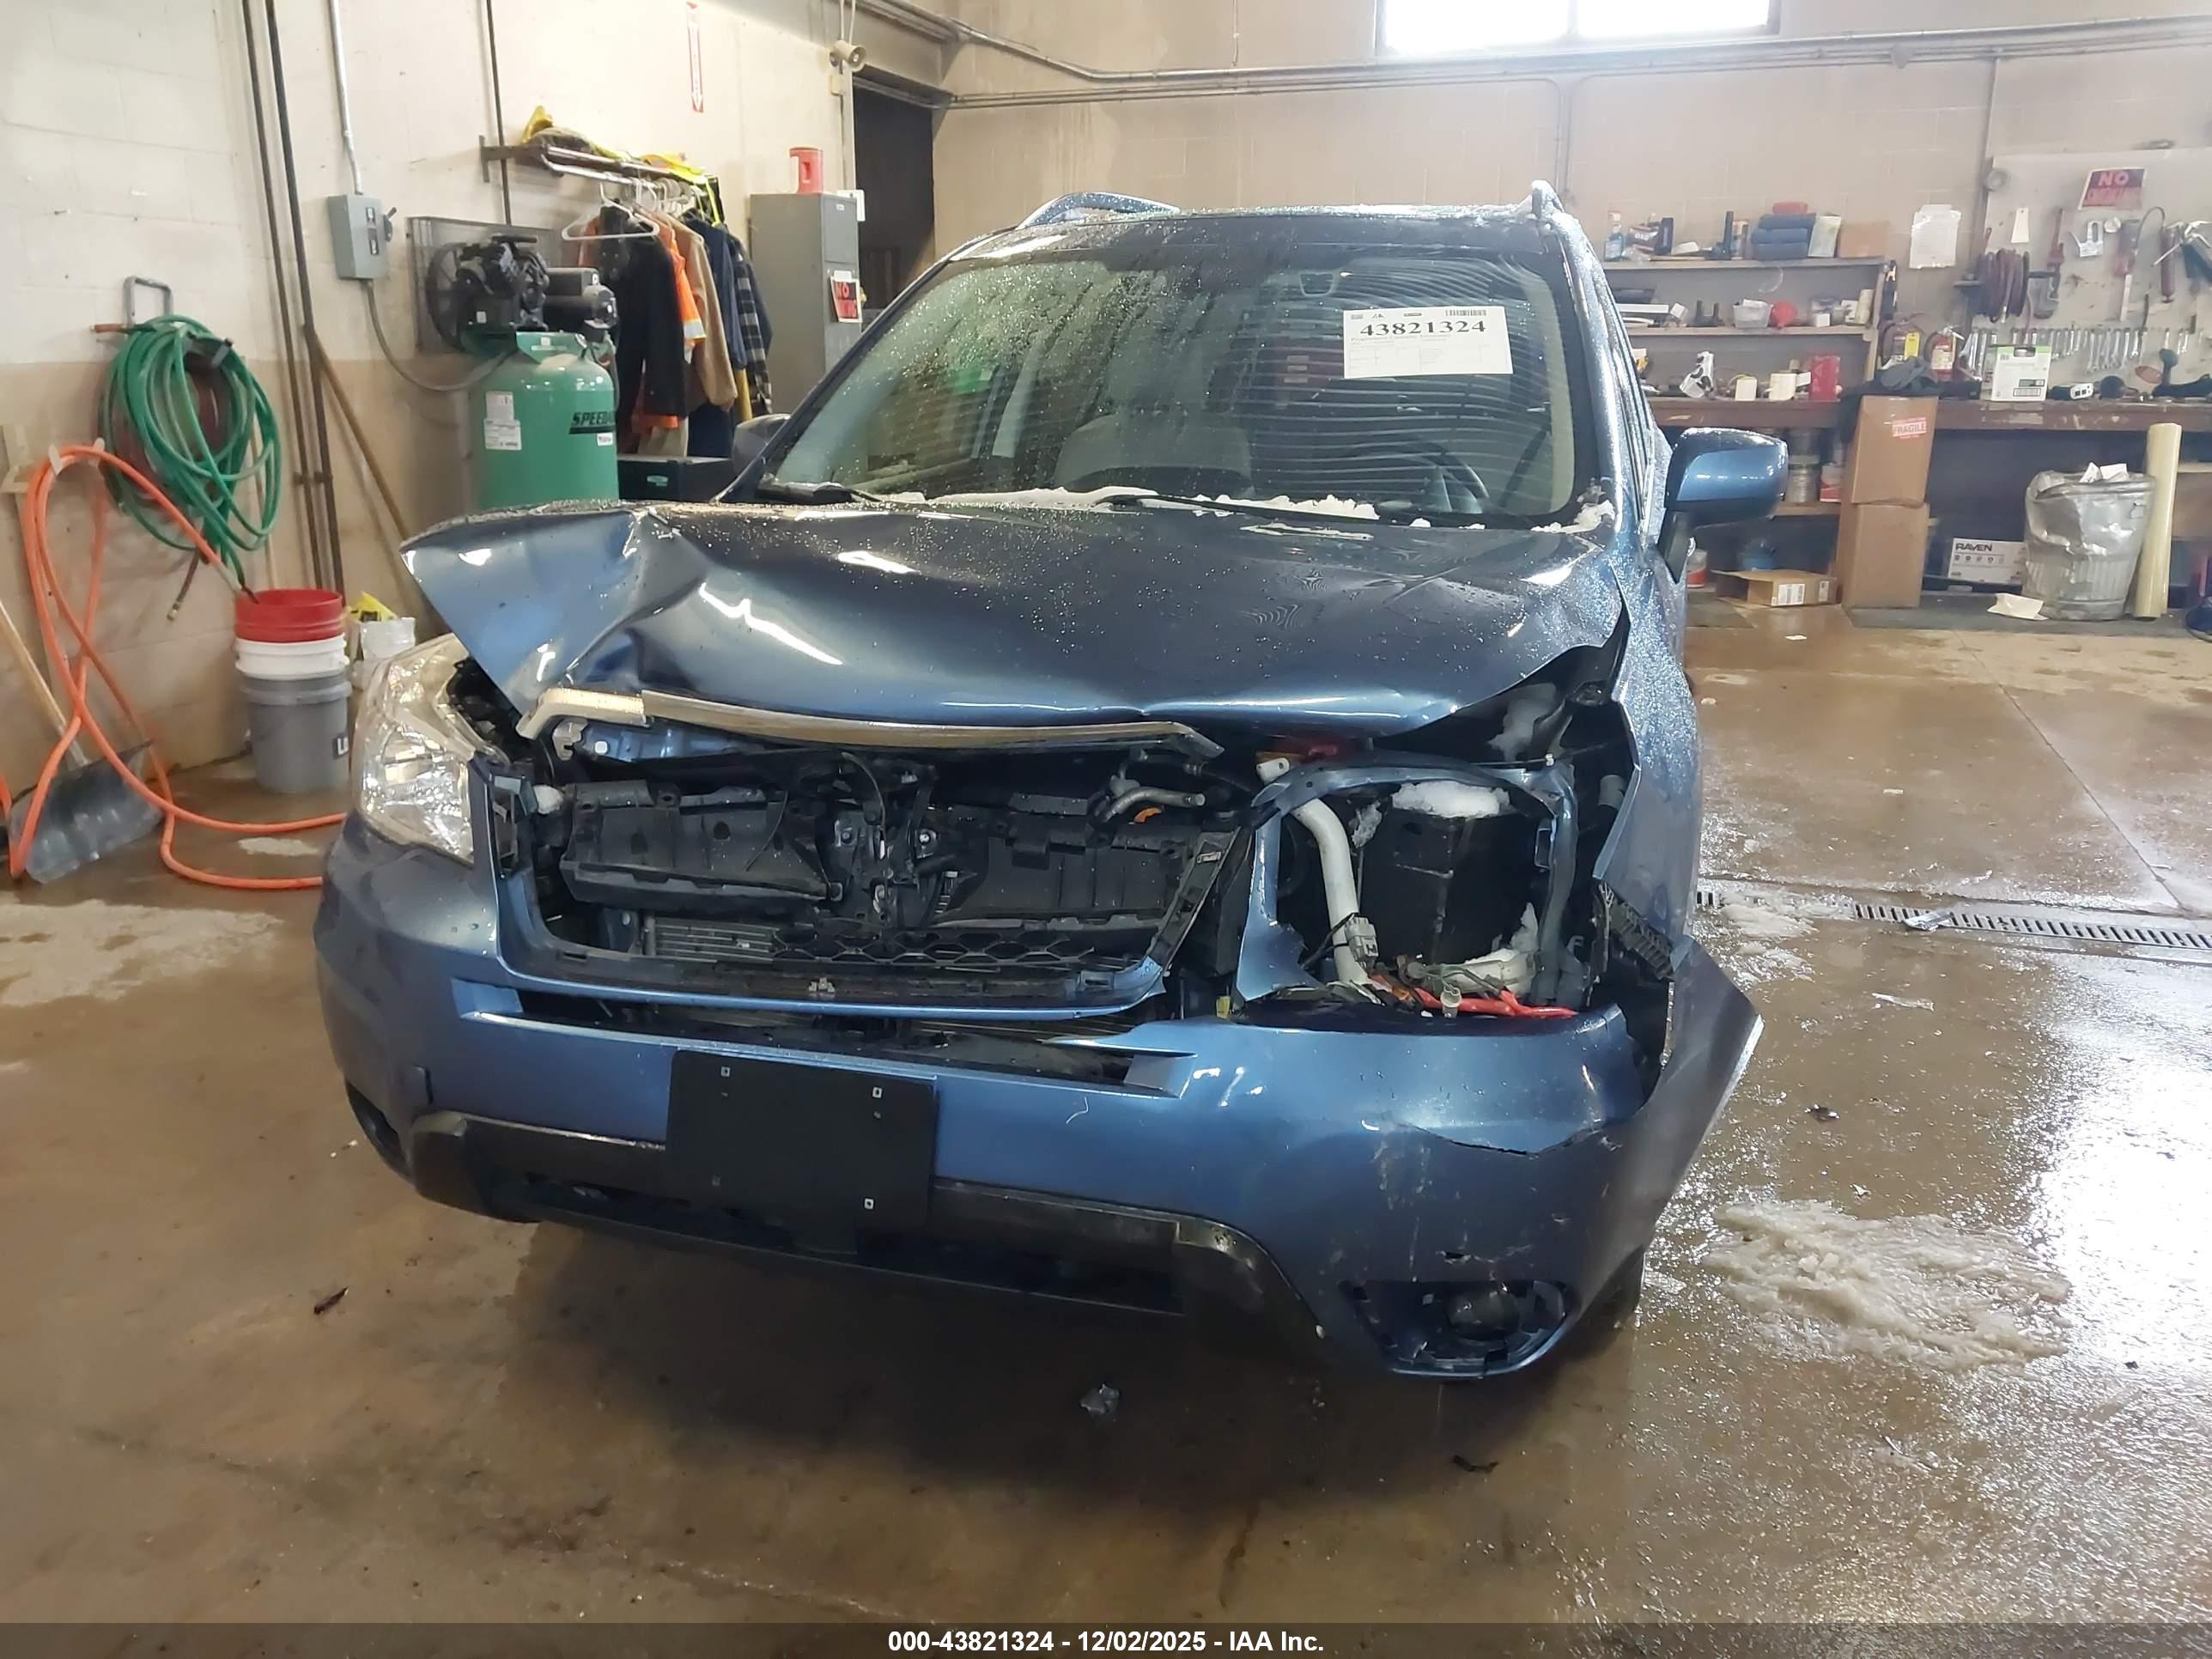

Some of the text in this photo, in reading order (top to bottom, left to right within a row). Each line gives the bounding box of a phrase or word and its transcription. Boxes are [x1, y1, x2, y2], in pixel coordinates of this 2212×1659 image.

[2098, 171, 2130, 186] NO
[1360, 320, 1486, 336] 43821324
[1955, 543, 1992, 552] RAVEN
